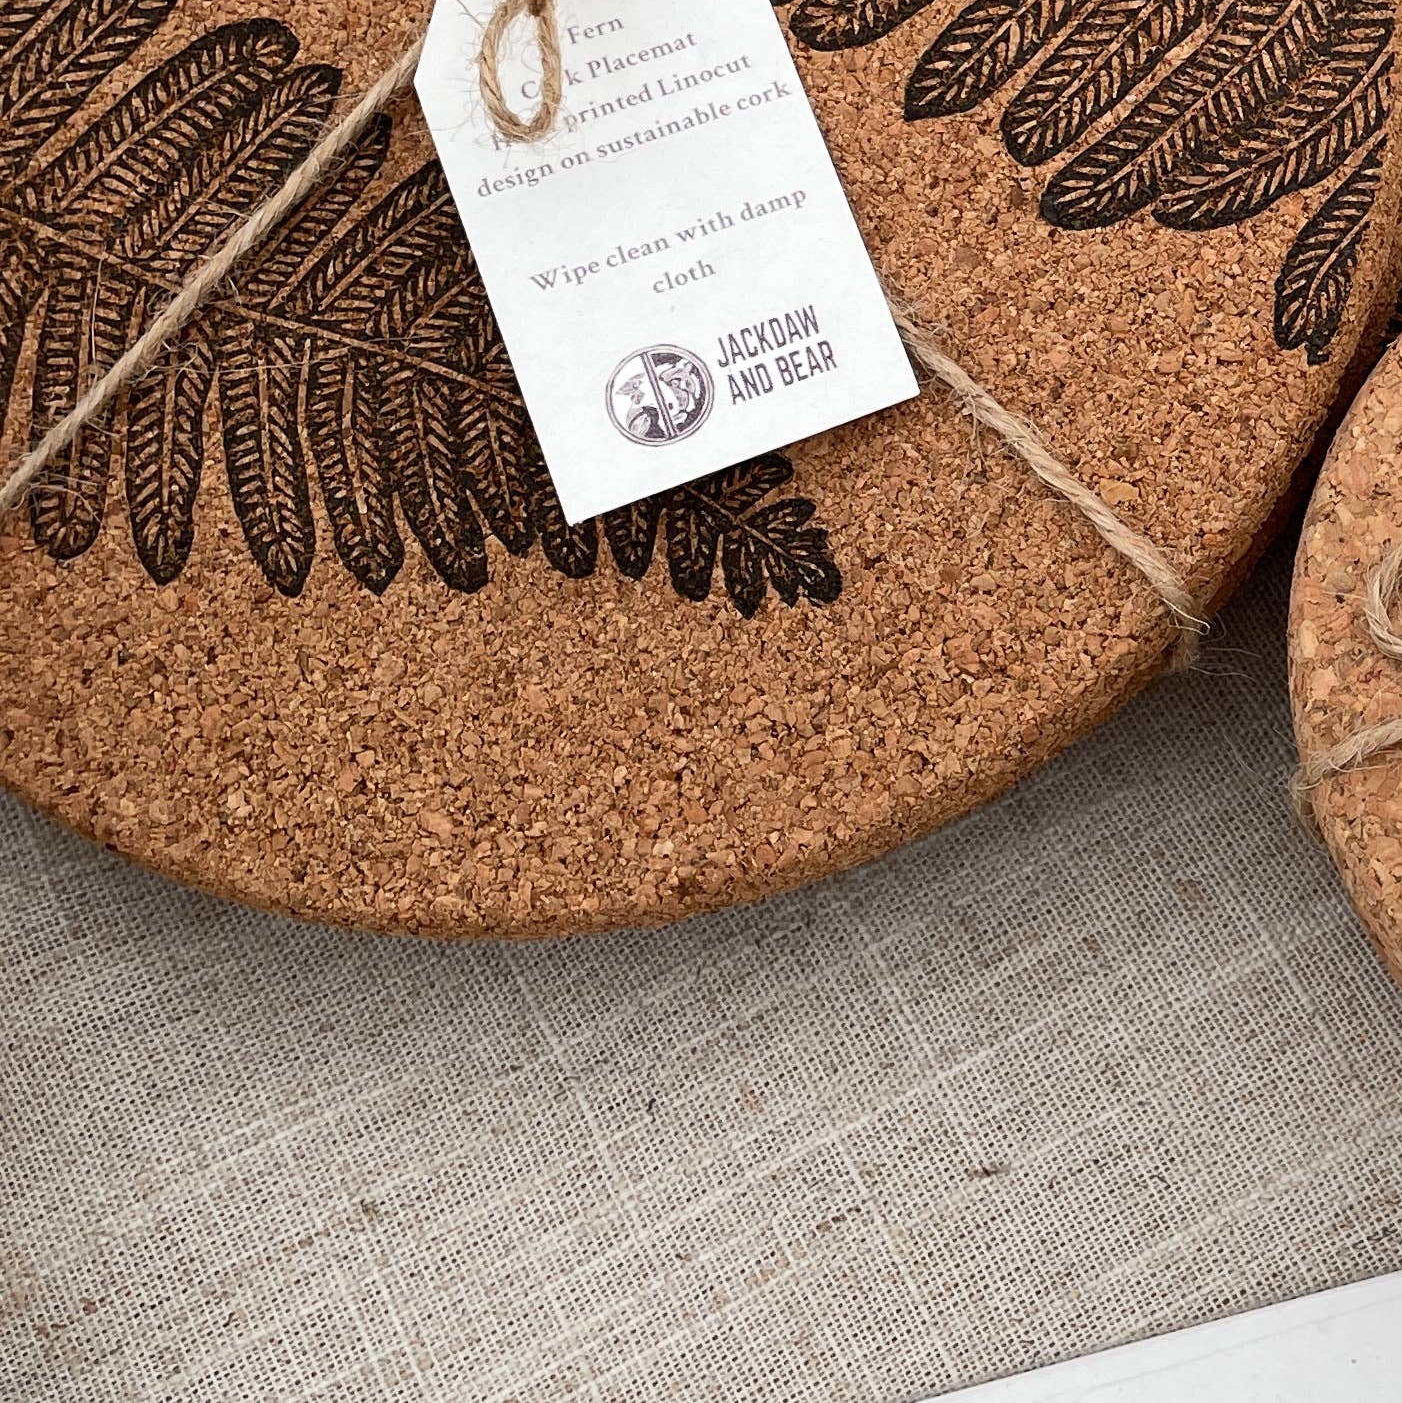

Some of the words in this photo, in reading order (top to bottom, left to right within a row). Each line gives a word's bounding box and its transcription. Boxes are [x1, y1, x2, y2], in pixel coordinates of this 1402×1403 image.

[566, 18, 625, 46] Fern
[520, 68, 583, 100] Ck
[586, 32, 699, 80] Placemat
[563, 82, 655, 134] printed
[656, 55, 752, 97] Linocut
[477, 162, 555, 199] design
[560, 149, 592, 171] on
[595, 101, 733, 160] sustainable
[736, 79, 791, 112] cork
[527, 260, 601, 293] Wipe
[605, 237, 673, 269] clean
[674, 210, 737, 244] with
[739, 188, 808, 223] damp
[652, 259, 718, 295] cloth
[716, 304, 821, 368] JACKDAW
[727, 362, 775, 405] AND
[777, 339, 839, 387] BEAR
